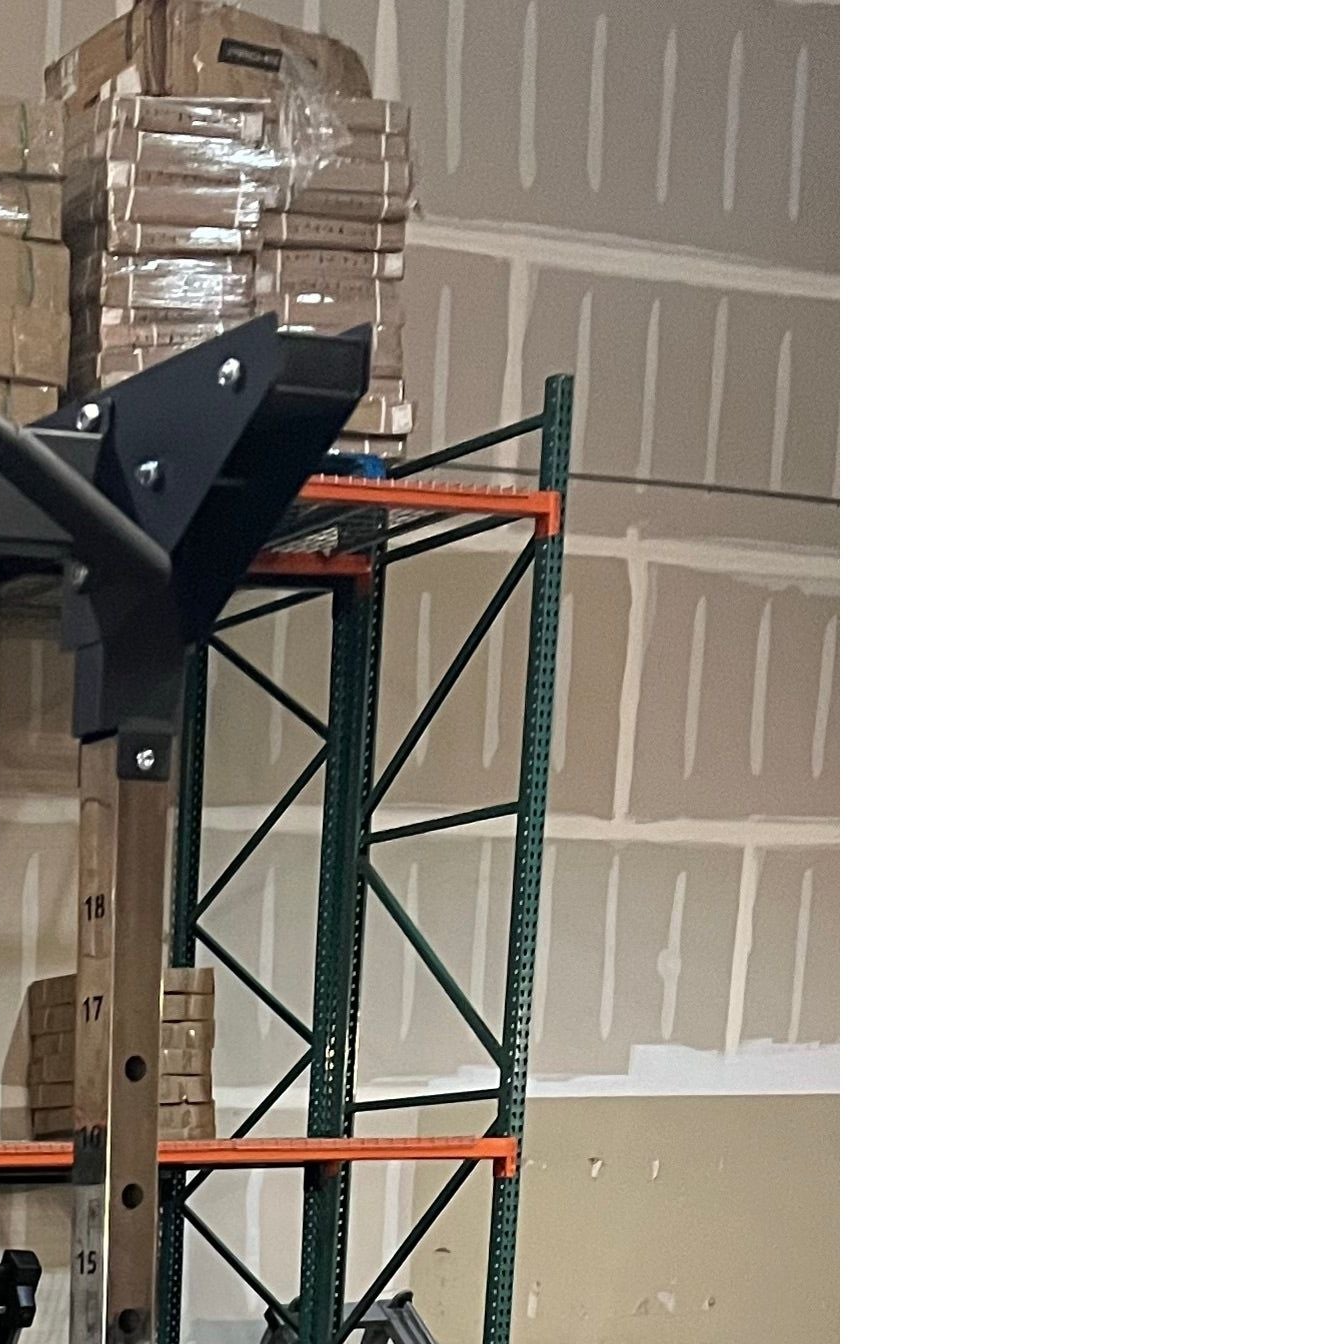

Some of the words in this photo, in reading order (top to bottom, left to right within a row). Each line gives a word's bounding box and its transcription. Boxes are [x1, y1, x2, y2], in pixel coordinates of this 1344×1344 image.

[84, 893, 106, 922] 18
[82, 995, 104, 1023] 17
[77, 1250, 98, 1276] 15
